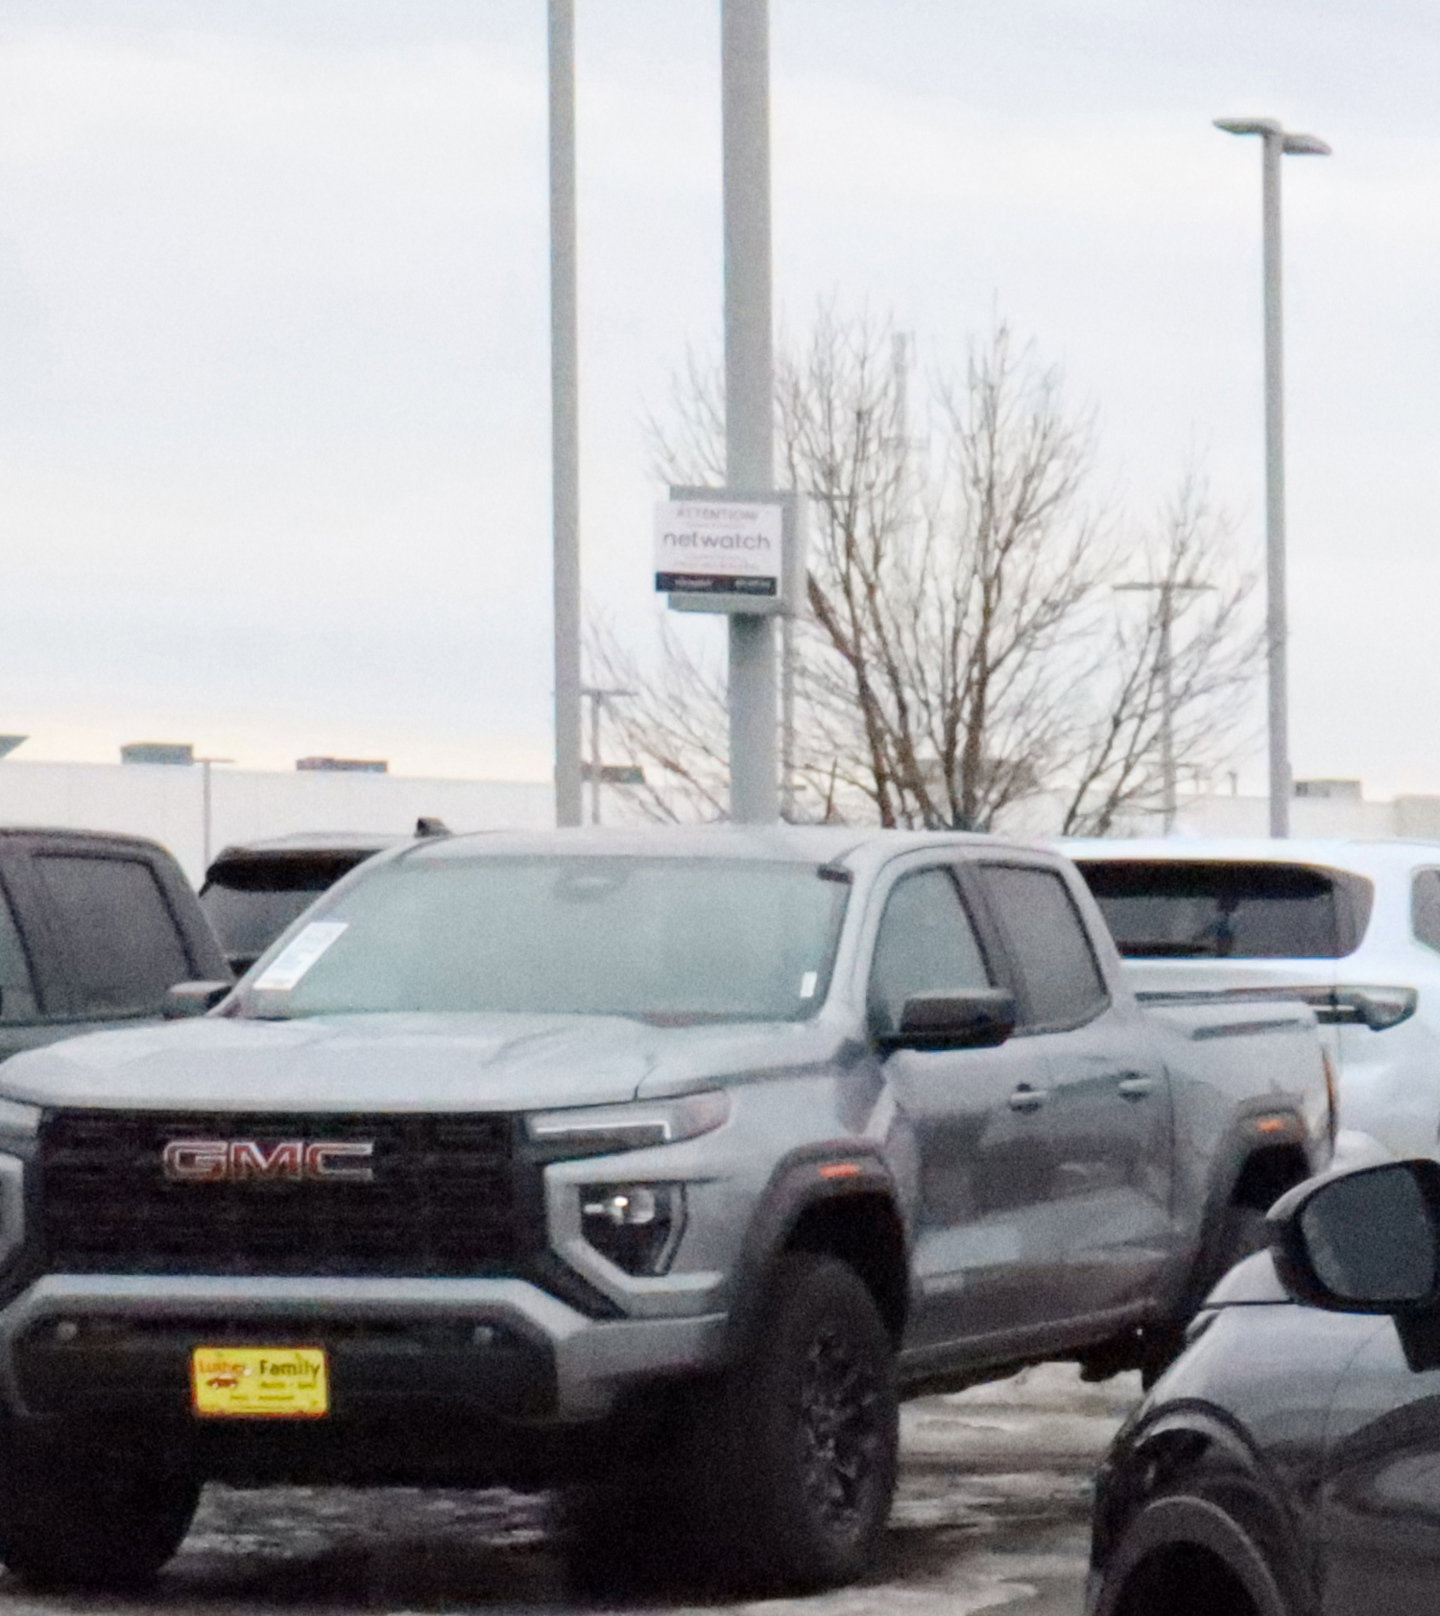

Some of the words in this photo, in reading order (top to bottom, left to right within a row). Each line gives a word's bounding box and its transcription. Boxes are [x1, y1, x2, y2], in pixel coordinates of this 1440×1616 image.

[663, 531, 771, 550] netwatch
[163, 1141, 374, 1181] GMC
[259, 1359, 320, 1380] Family
